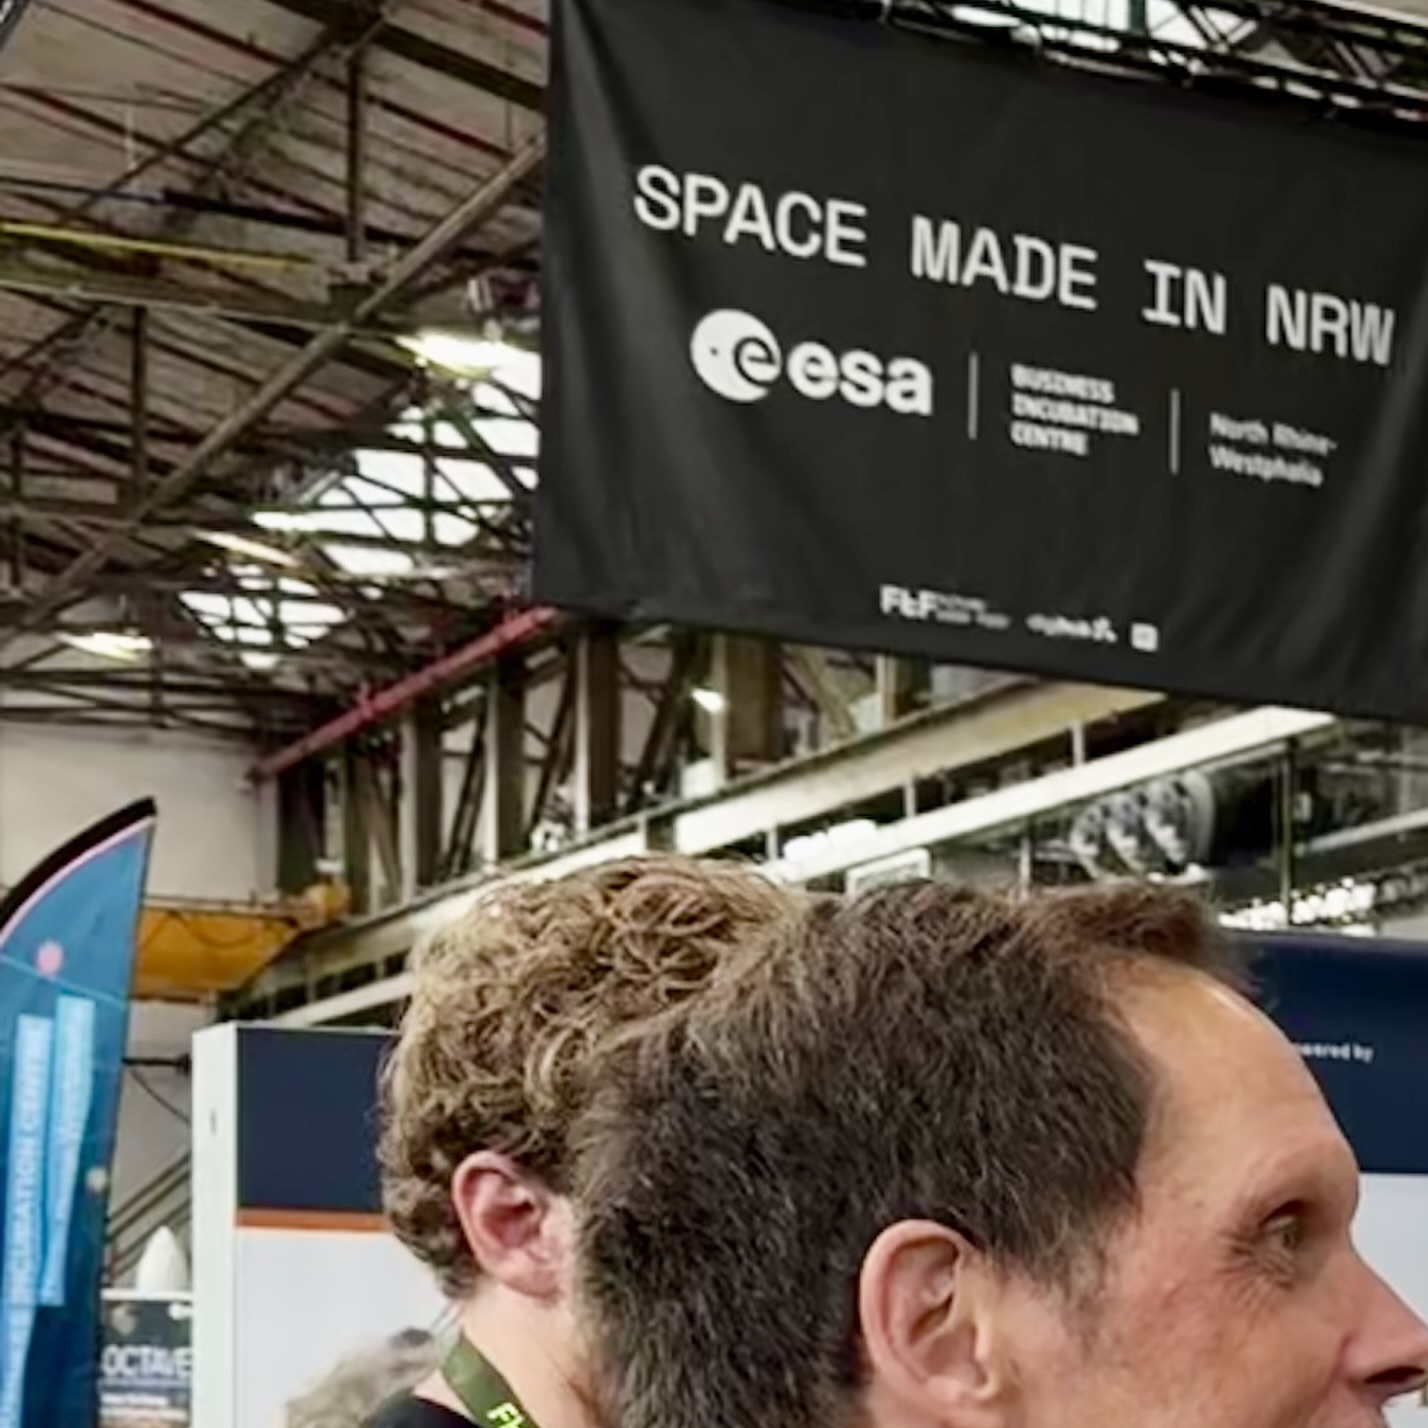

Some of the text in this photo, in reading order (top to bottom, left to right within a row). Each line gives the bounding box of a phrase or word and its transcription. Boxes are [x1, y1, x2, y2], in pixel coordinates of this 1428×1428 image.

[633, 165, 1395, 367] SPACE MADE IN NRW
[786, 341, 934, 417] esa
